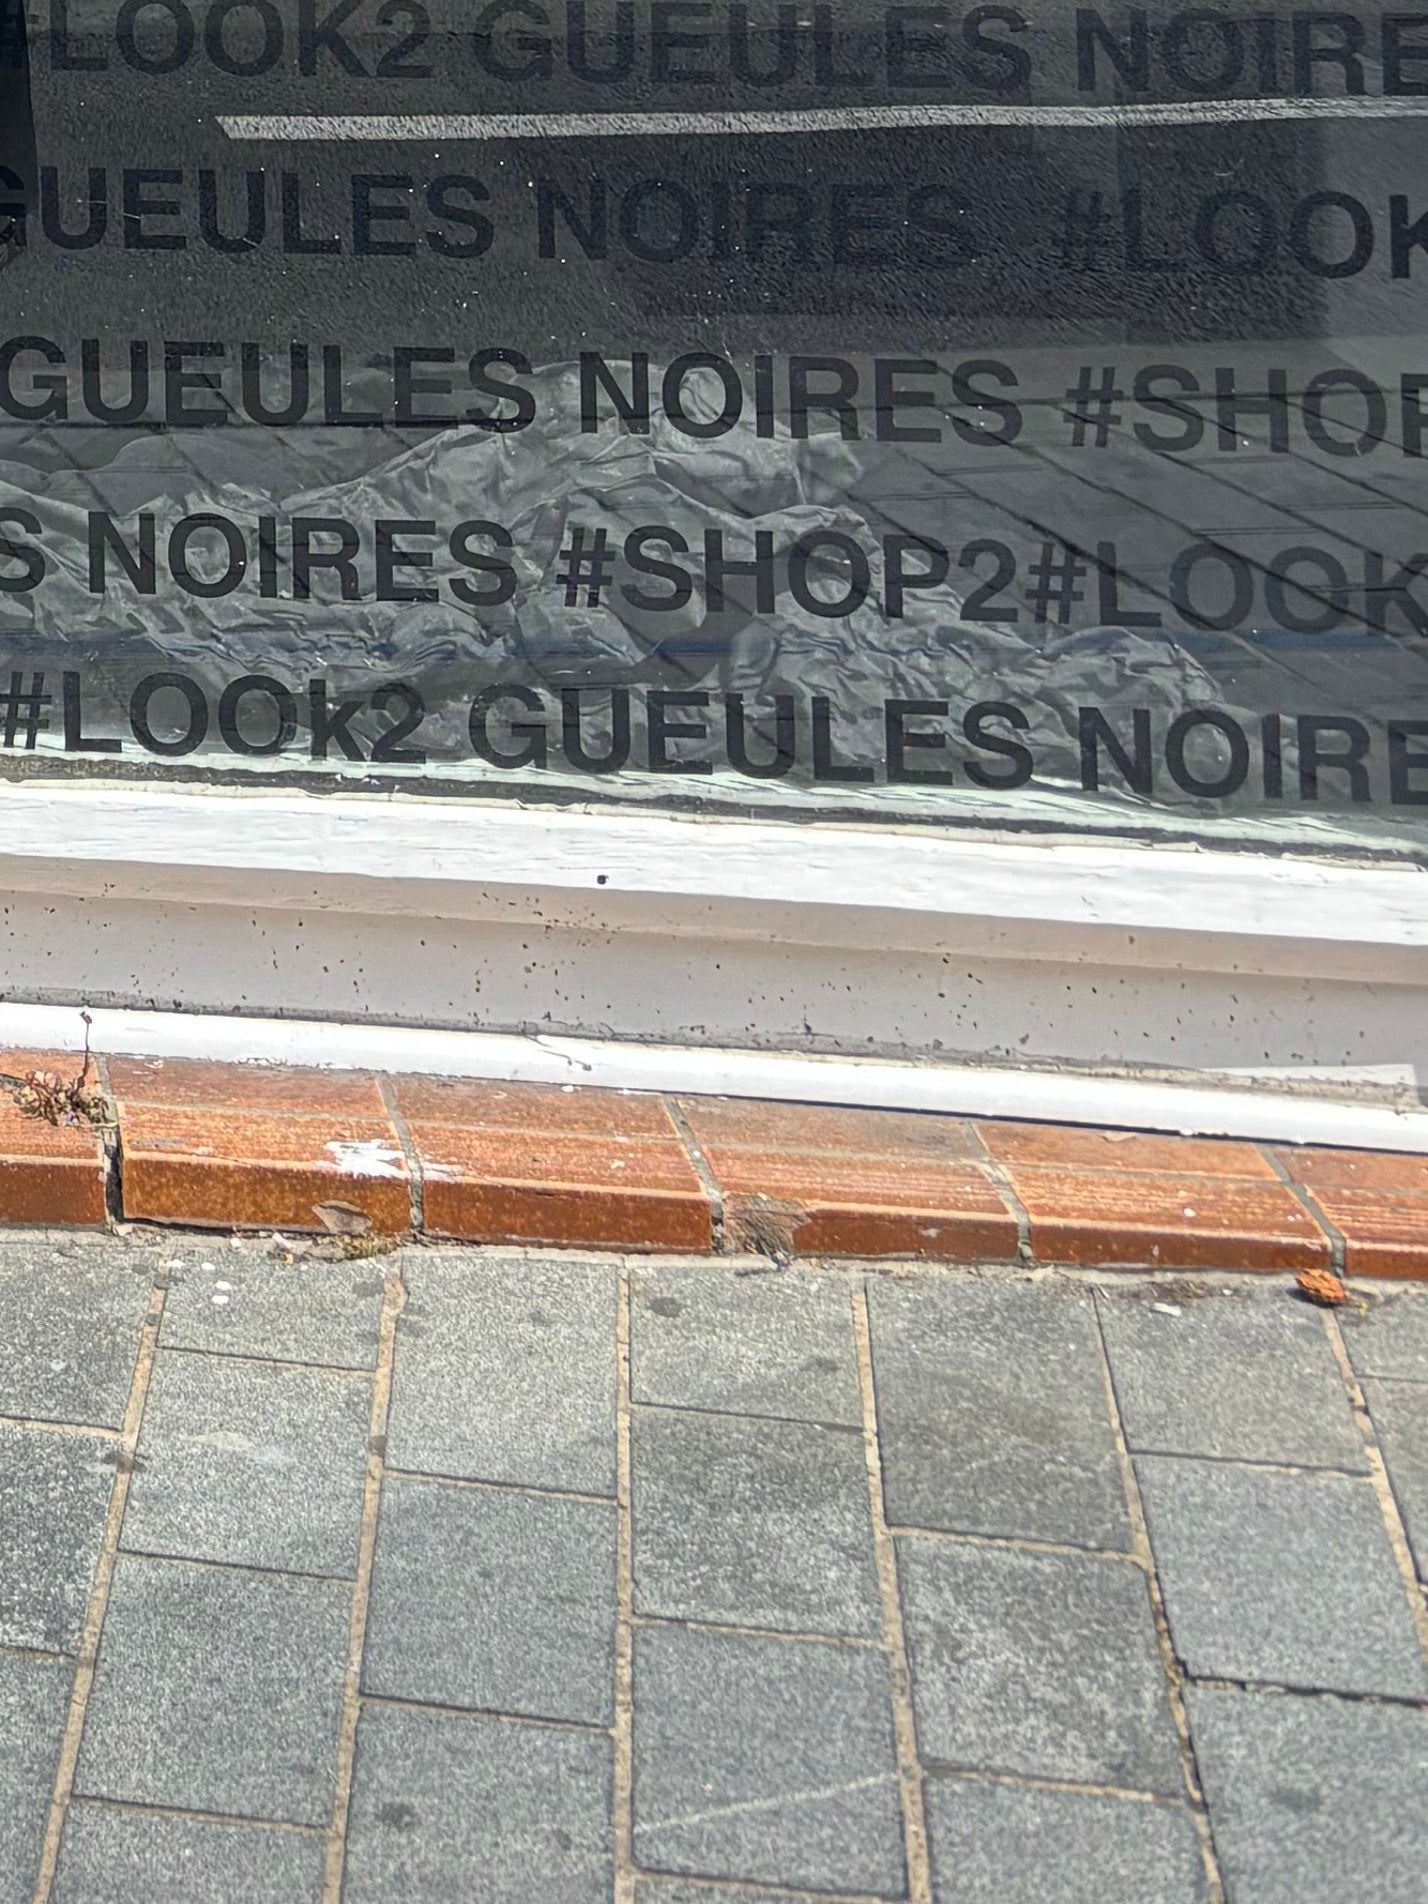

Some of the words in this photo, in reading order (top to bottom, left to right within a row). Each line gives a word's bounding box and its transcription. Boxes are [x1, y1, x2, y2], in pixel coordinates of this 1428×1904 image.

[580, 351, 1022, 447] NOIRES
[89, 512, 517, 606] NOIRES
[469, 684, 1035, 789] GUEULES
